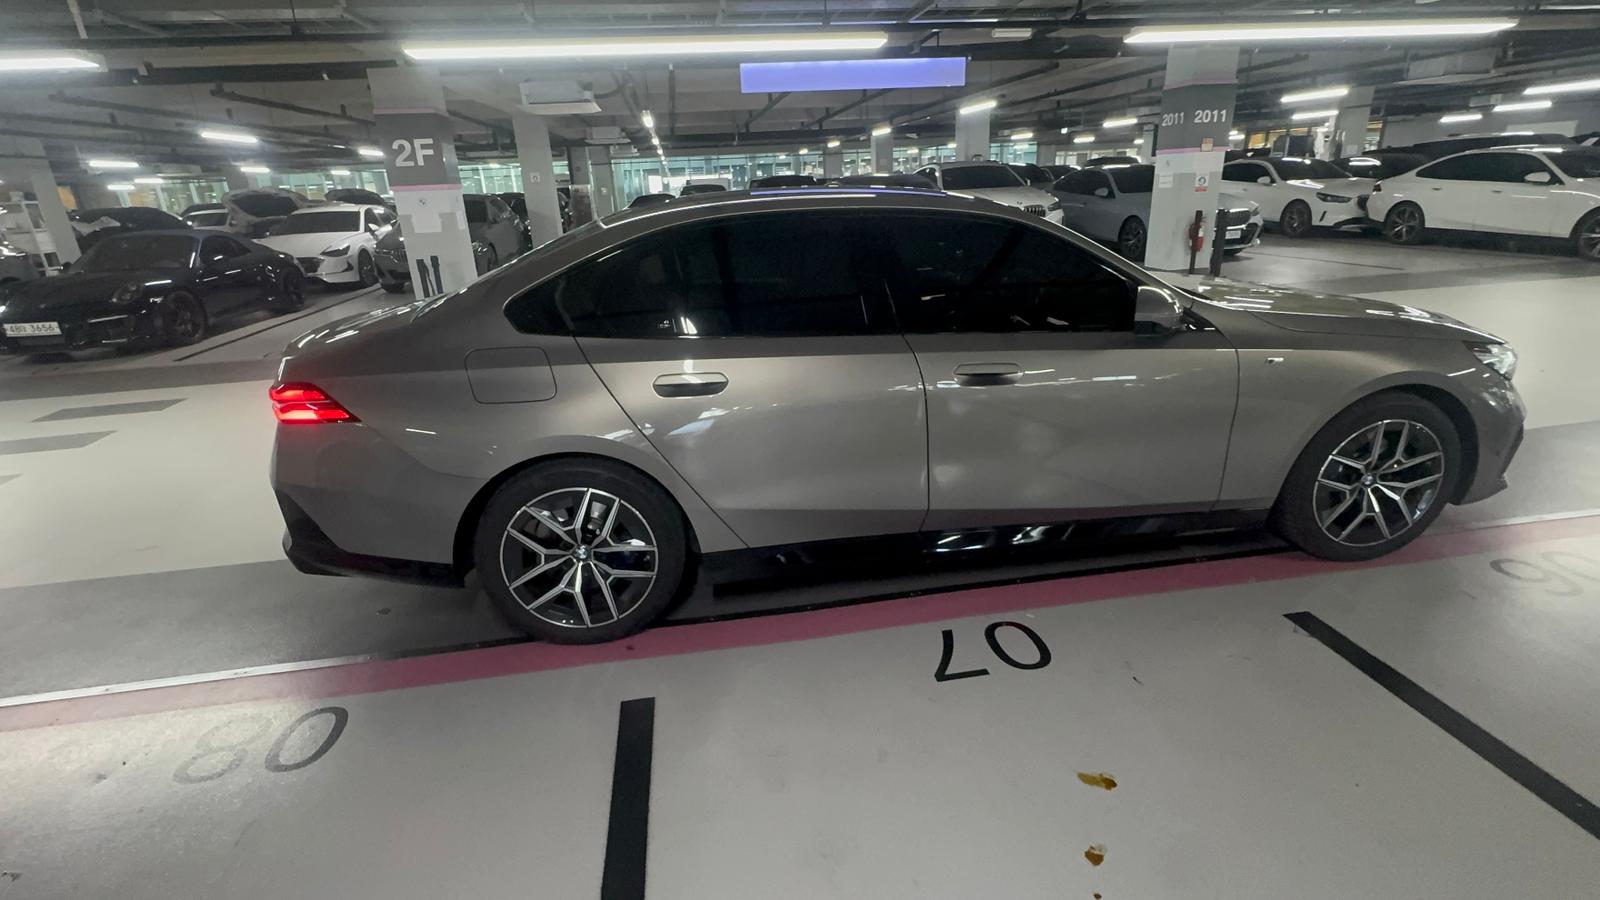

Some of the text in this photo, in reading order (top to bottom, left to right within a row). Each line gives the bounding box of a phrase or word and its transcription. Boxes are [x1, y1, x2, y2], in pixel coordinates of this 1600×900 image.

[1161, 112, 1185, 127] 2011
[1194, 109, 1227, 123] 2011
[392, 138, 434, 167] 2F
